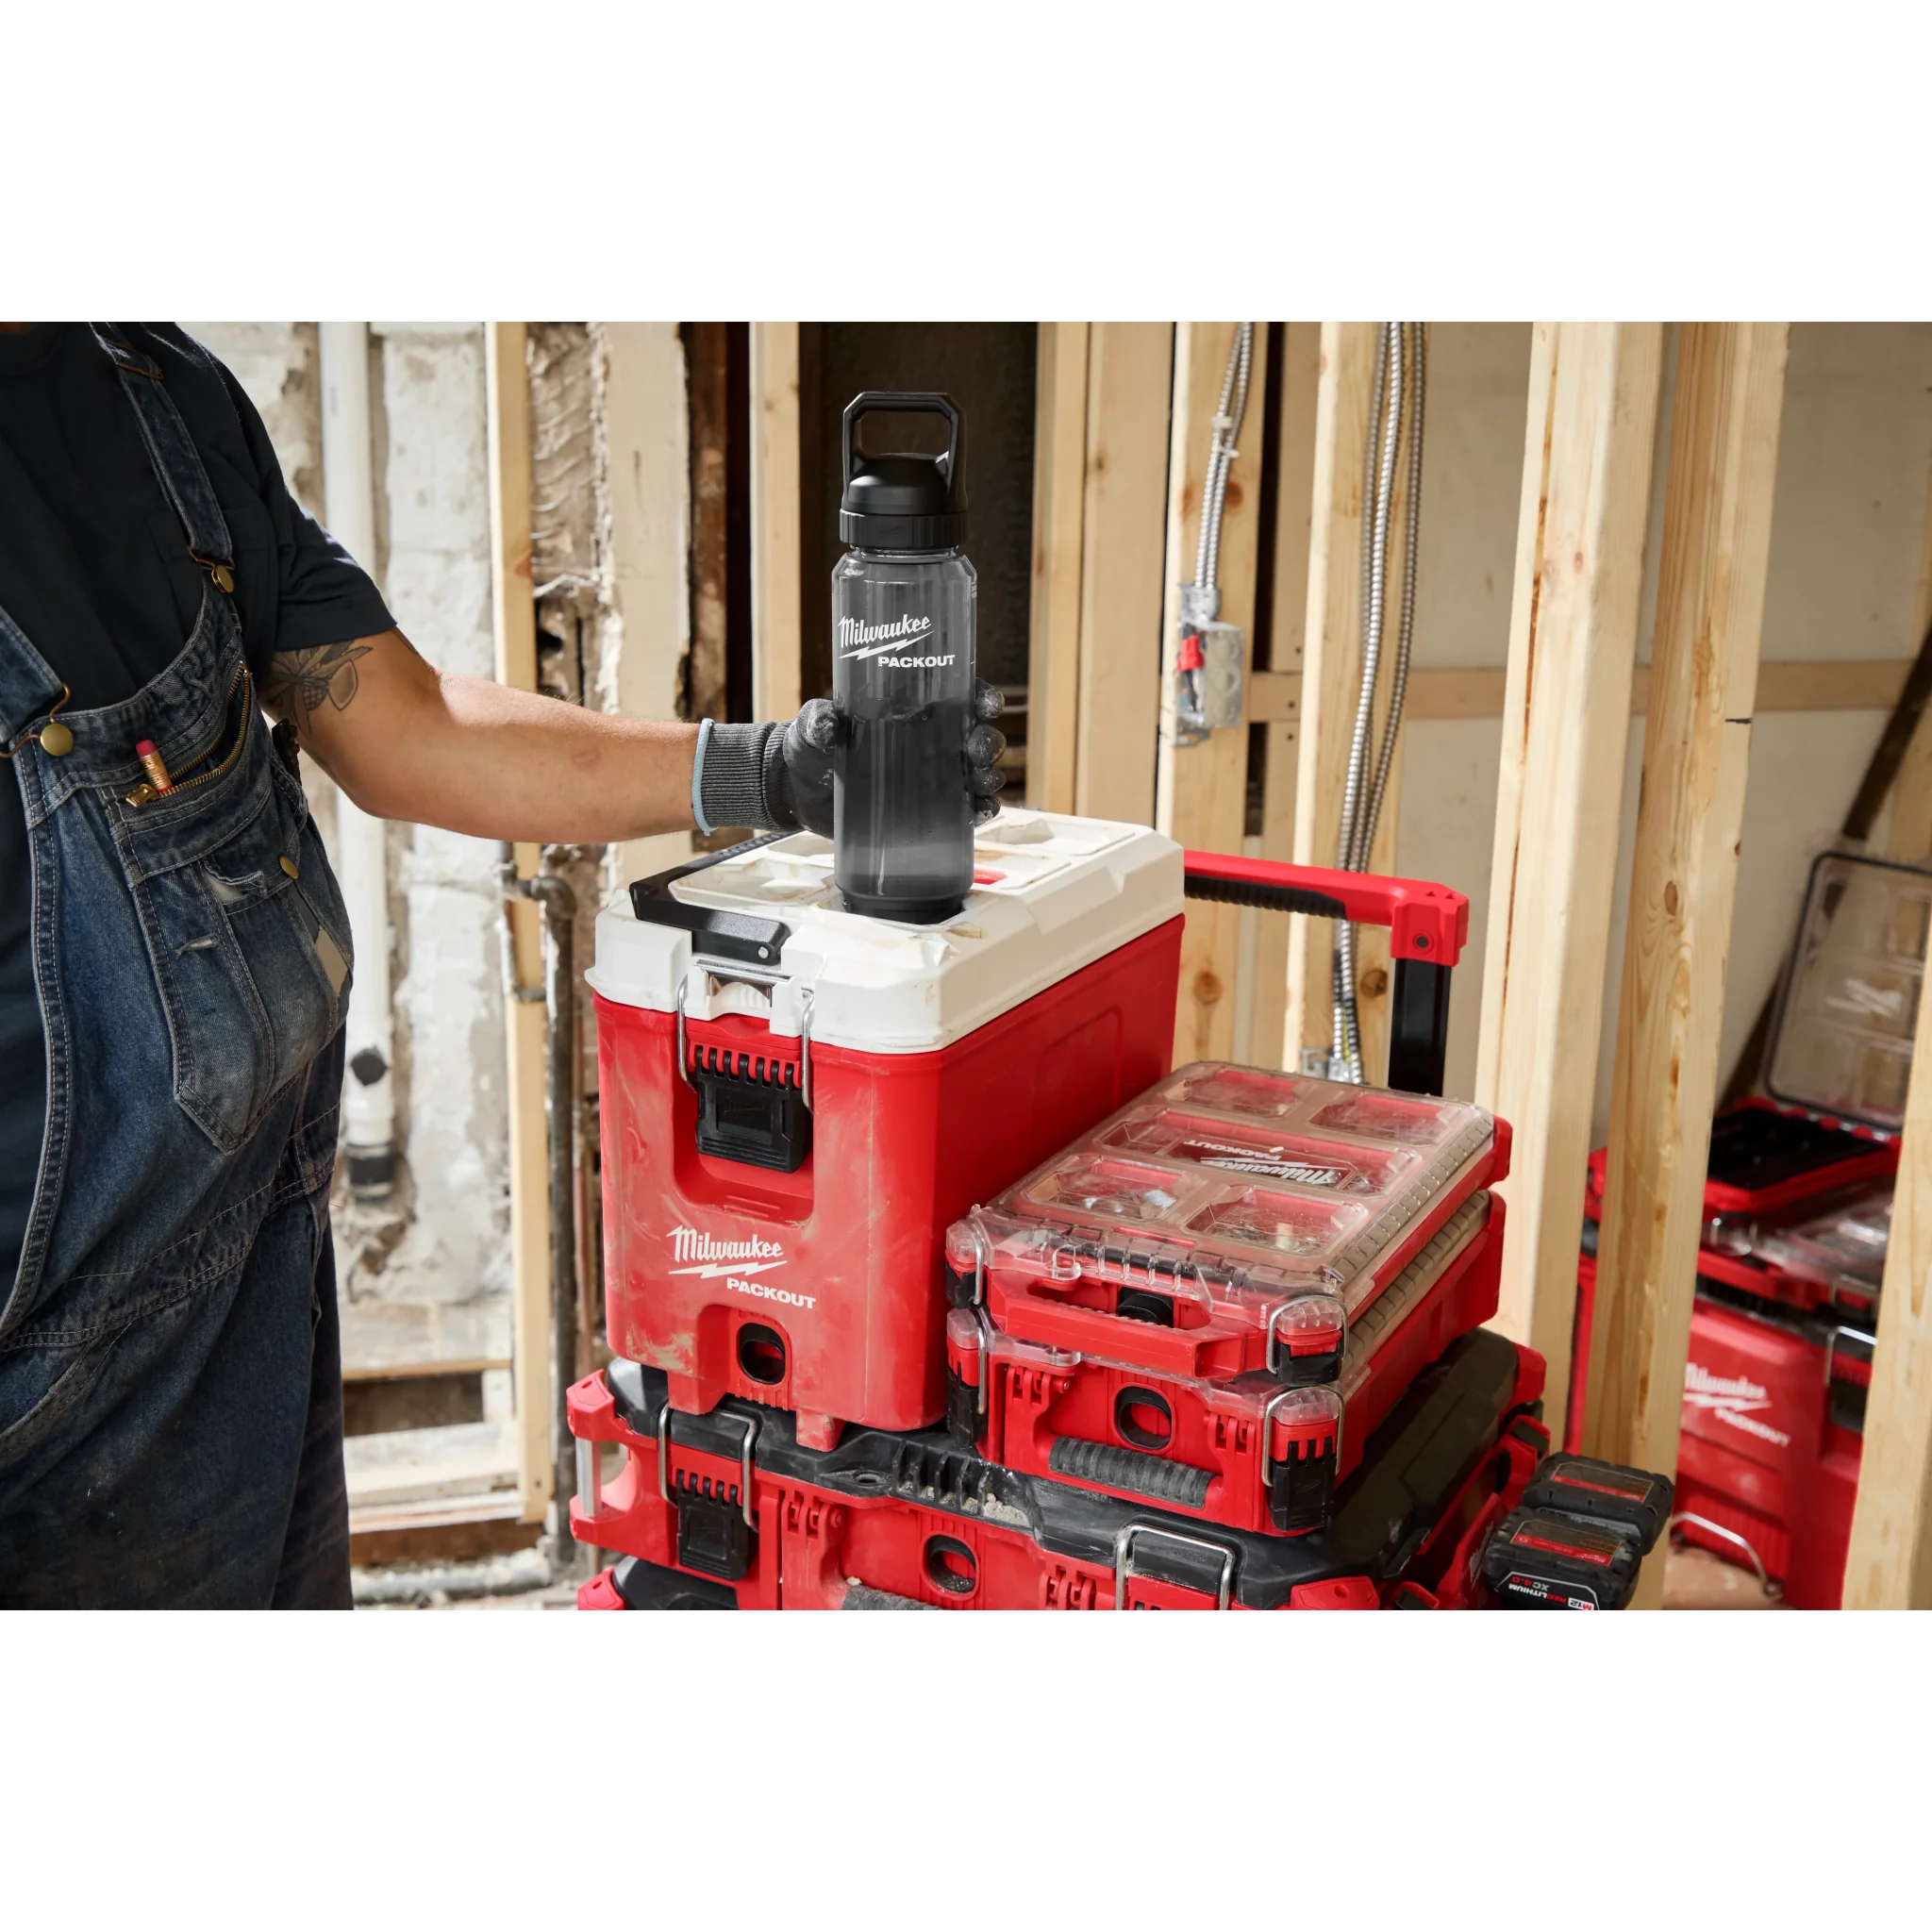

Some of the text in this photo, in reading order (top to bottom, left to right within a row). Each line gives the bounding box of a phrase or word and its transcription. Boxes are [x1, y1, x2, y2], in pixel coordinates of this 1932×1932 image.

[838, 614, 932, 648] Milwaukee
[877, 654, 956, 668] PACKOUT
[1184, 1140, 1281, 1161] PACKOUT
[666, 1224, 784, 1263] Milwaukee
[726, 1277, 816, 1309] PACKOUT
